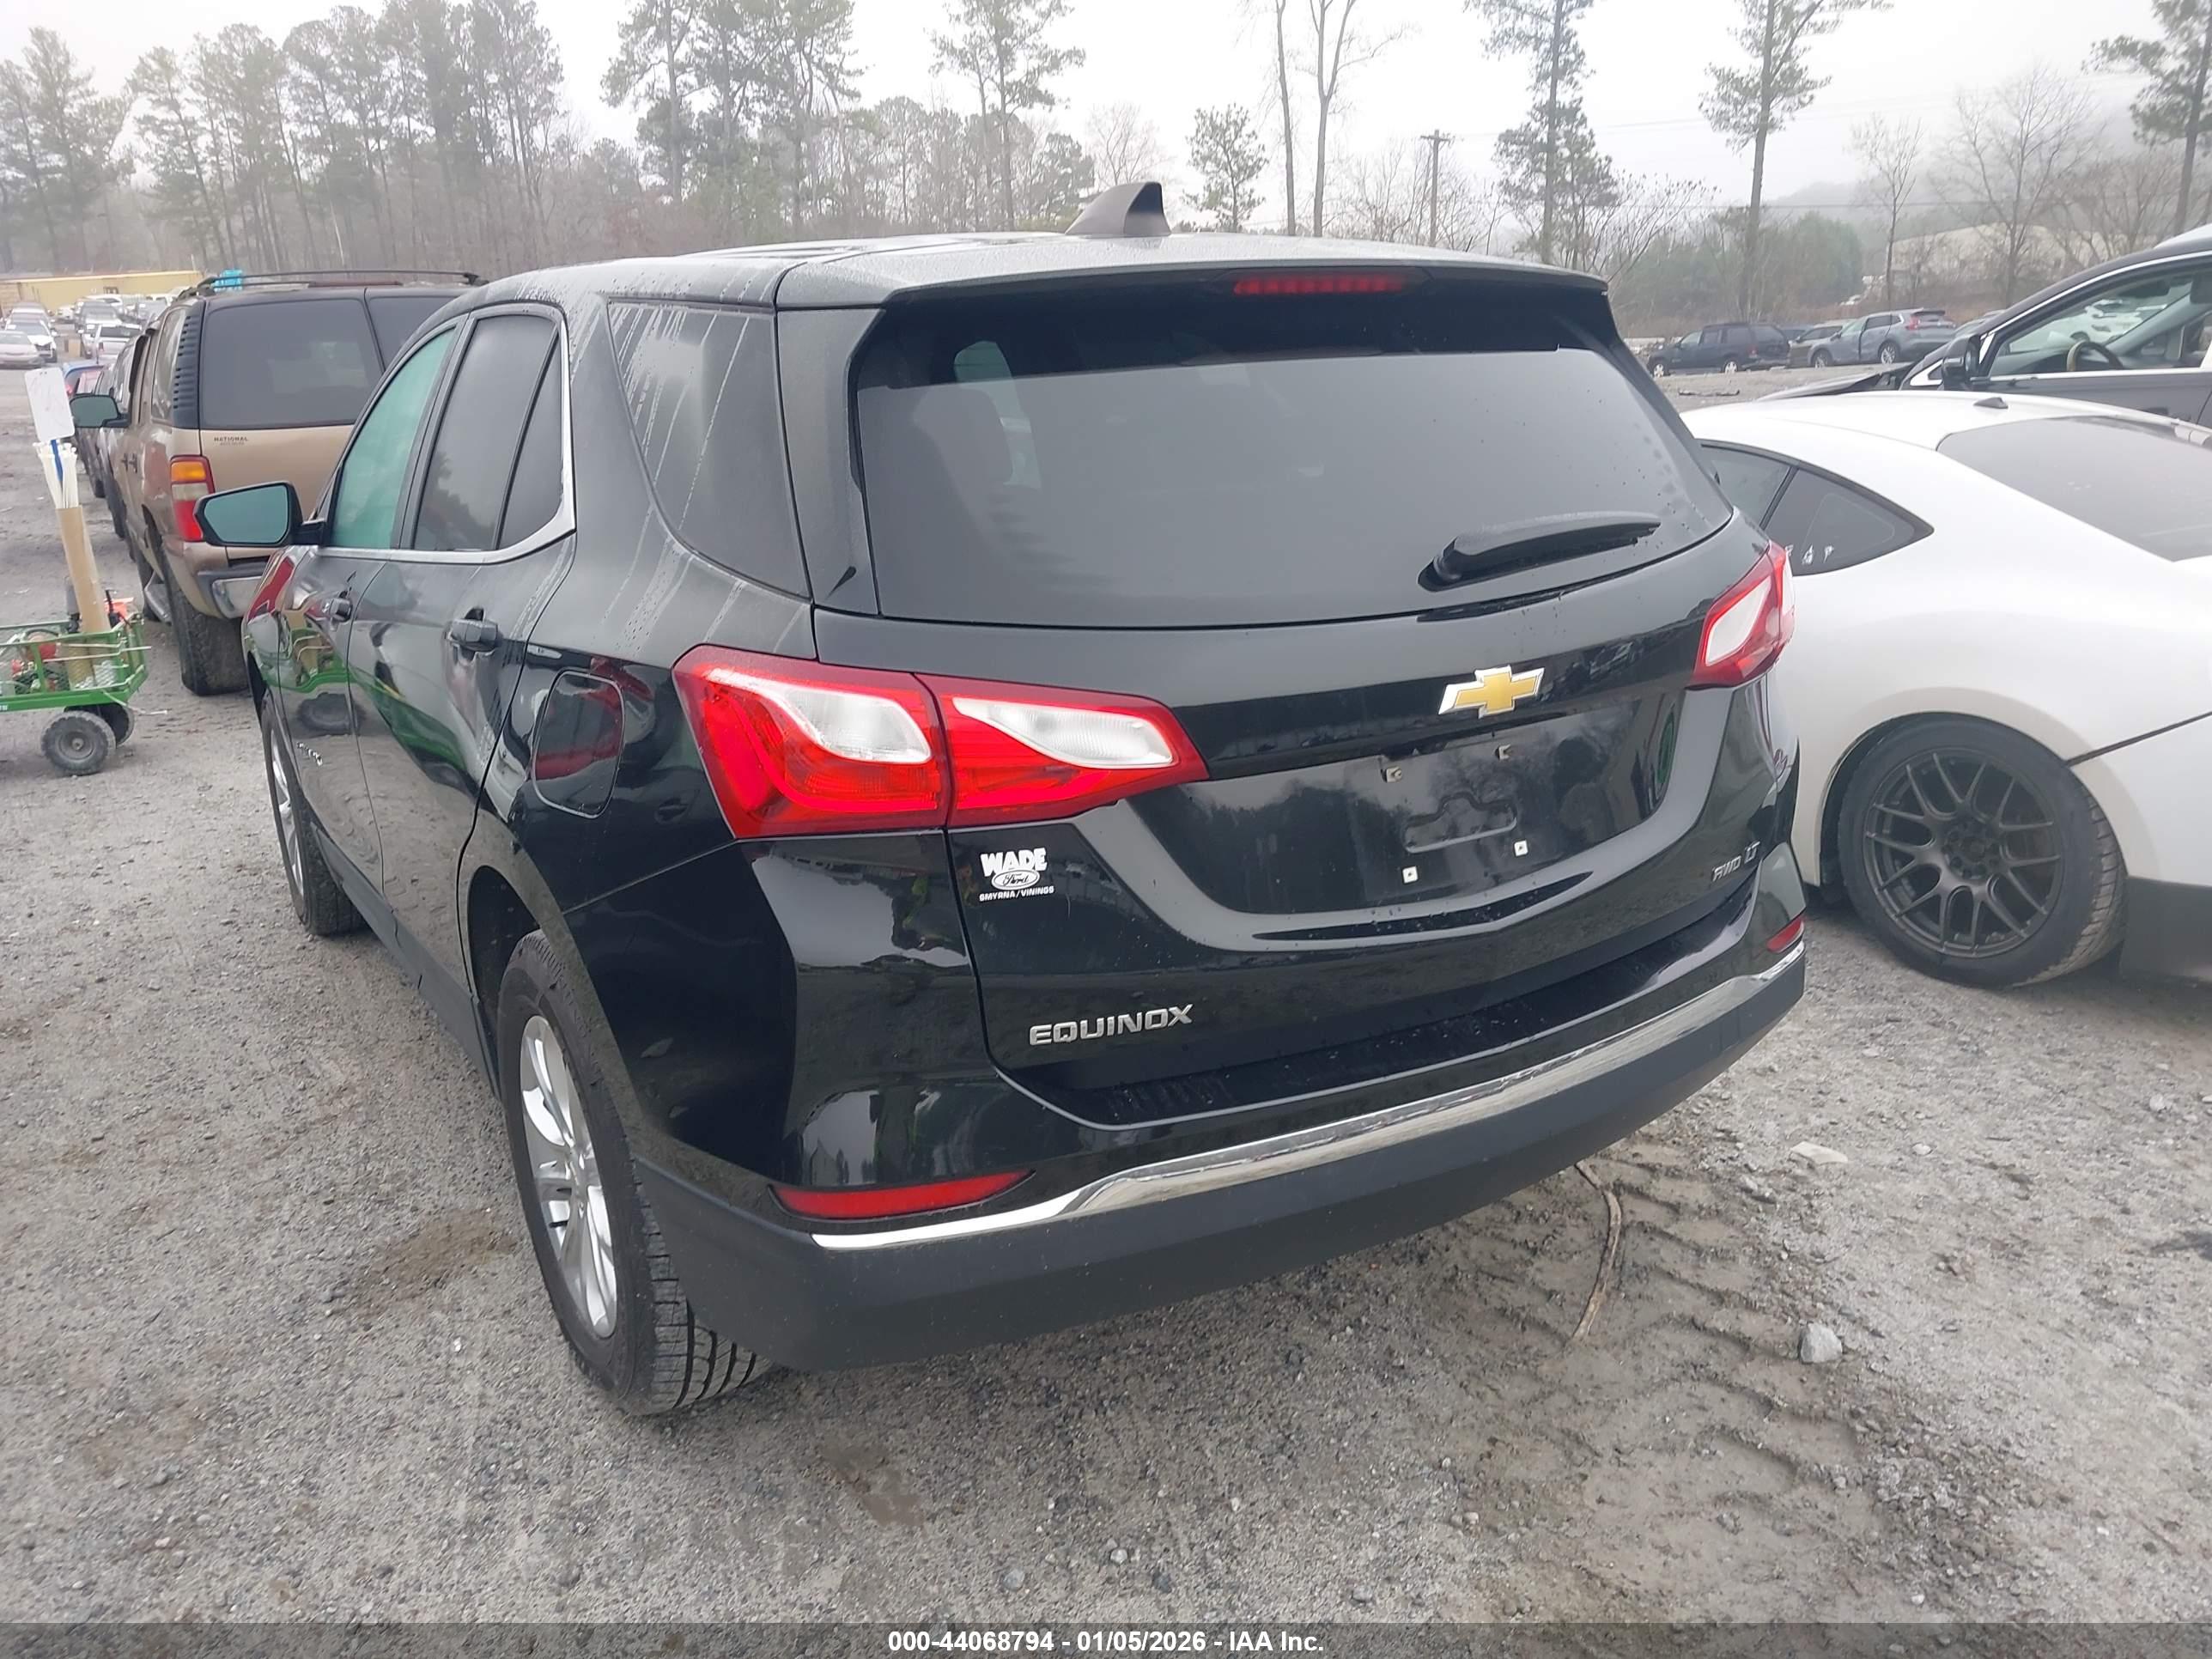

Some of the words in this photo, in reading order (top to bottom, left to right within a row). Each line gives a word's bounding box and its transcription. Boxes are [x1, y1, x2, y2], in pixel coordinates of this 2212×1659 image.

[980, 847, 1048, 877] WADE
[1712, 855, 1741, 882] AWD
[1744, 841, 1760, 864] LT
[1002, 872, 1030, 887] Ford
[1030, 1003, 1194, 1046] EQUINOX
